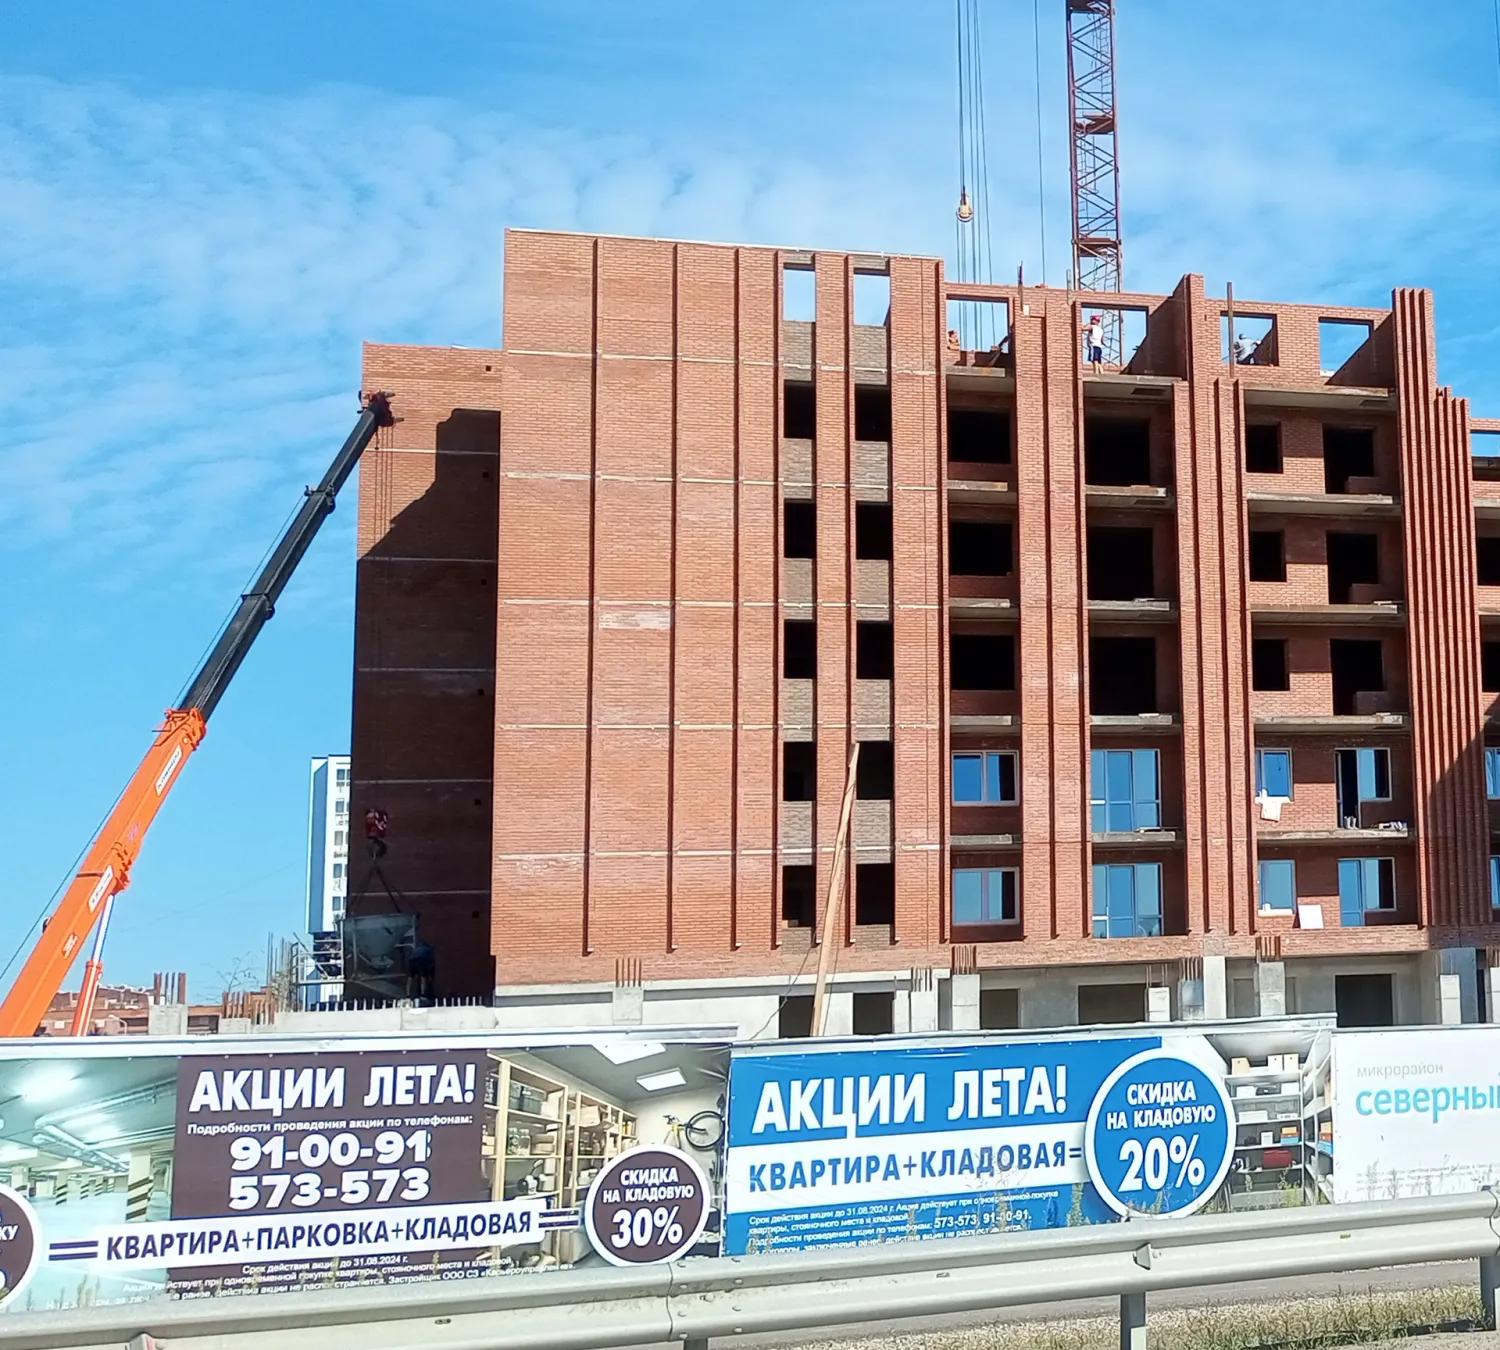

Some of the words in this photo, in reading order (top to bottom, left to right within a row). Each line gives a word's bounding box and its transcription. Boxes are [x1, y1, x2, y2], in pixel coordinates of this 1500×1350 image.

[1357, 1063, 1443, 1079] микрорайон
[188, 1067, 345, 1117] АКЦИИ
[364, 1063, 476, 1107] ЛЕТА!
[752, 1073, 926, 1138] АКЦИИ
[948, 1065, 1067, 1120] ЛЕТА!
[1127, 1081, 1196, 1106] СКИДКА
[187, 1123, 270, 1136] Подробности
[273, 1120, 346, 1133] проведения
[349, 1118, 384, 1129] акции
[387, 1118, 400, 1127] по
[404, 1115, 472, 1127] телефонам:
[1106, 1112, 1128, 1129] НА
[1134, 1105, 1216, 1128] КЛАДОВУЮ
[230, 1130, 429, 1171] 91-00-91
[1118, 1134, 1205, 1192] 20%
[229, 1167, 430, 1210] 573-573
[620, 1168, 678, 1186] СКИДКА
[603, 1190, 620, 1203] НА
[625, 1185, 694, 1202] КЛАДОВУЮ
[611, 1205, 683, 1248] 30%
[354, 1256, 400, 1266] 31.08.2024
